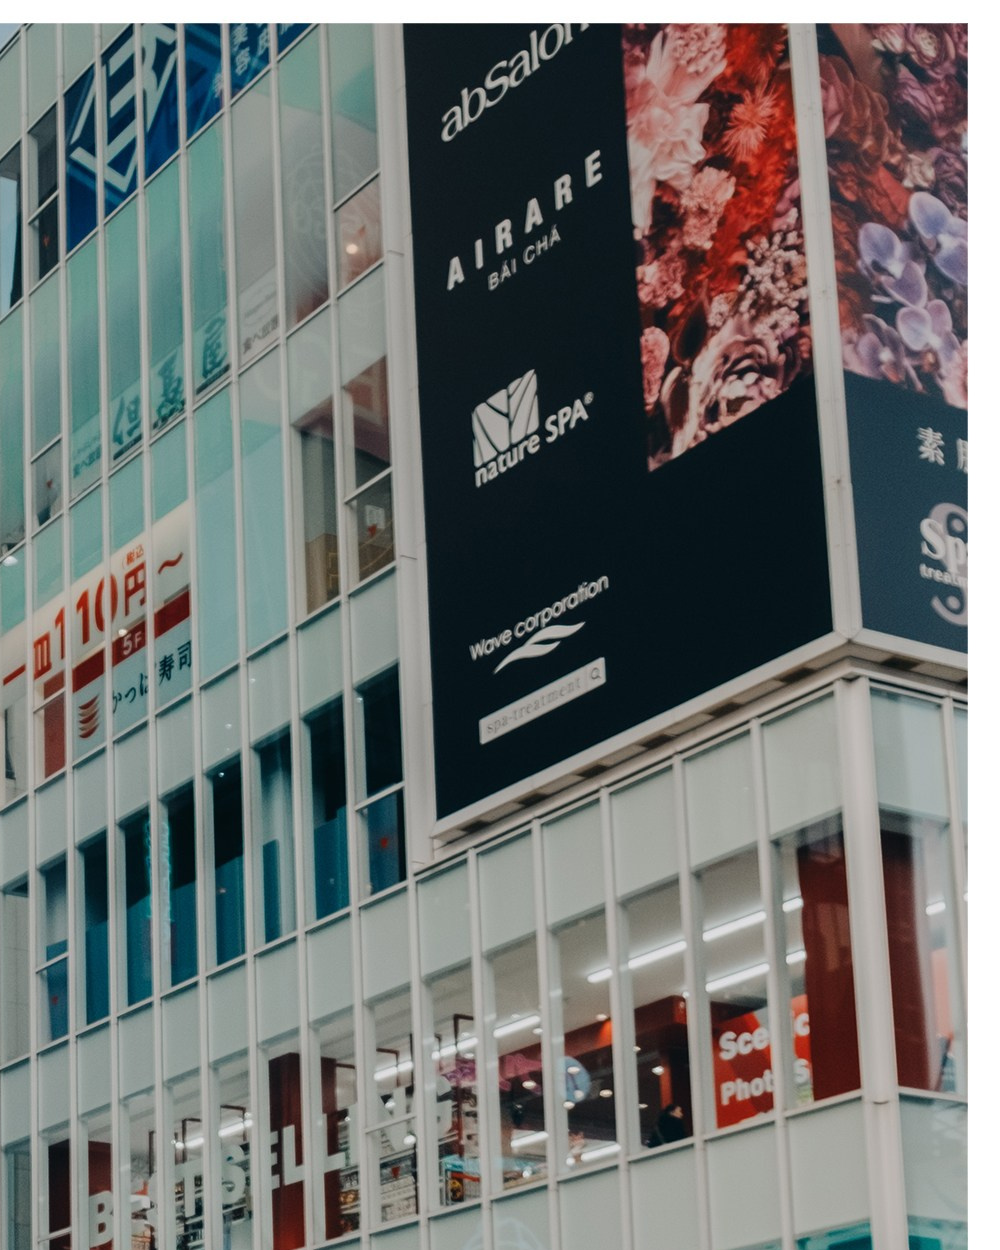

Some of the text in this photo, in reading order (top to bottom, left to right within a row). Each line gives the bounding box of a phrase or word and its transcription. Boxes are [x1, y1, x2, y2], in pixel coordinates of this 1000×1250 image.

[447, 149, 602, 291] AIRARE
[475, 434, 540, 488] nature
[920, 517, 968, 575] Sp
[122, 631, 143, 656] 5F
[468, 575, 609, 661] Wave corporation
[486, 676, 581, 734] spa-treatment
